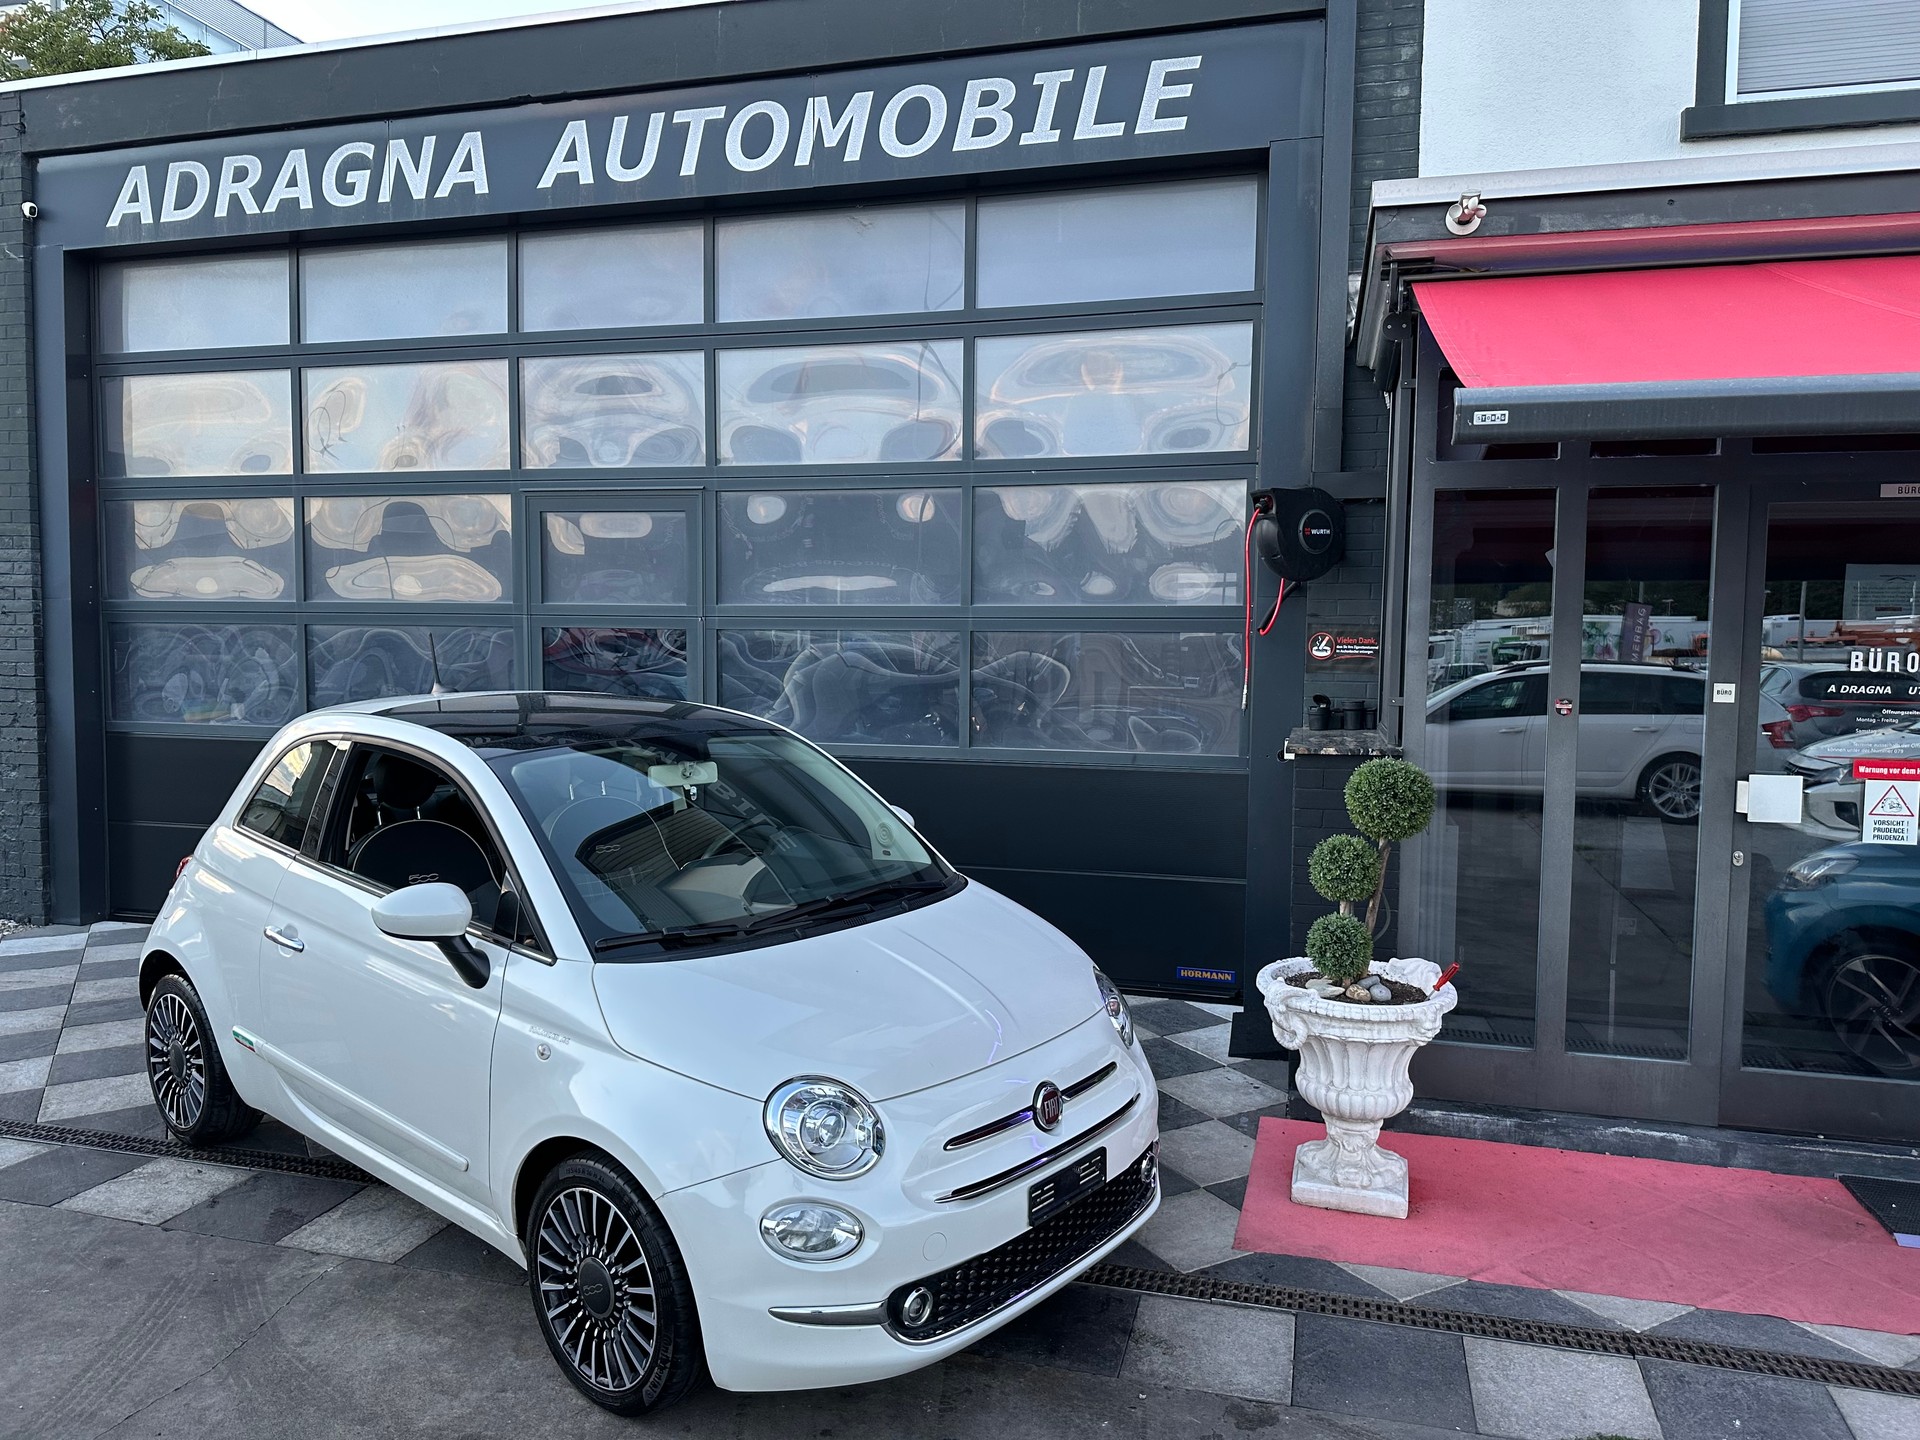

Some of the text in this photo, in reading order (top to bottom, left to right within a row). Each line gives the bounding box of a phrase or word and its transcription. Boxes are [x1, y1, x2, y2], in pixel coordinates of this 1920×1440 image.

[106, 55, 1203, 228] ADRAGNA AUTOMOBILE
[1336, 636, 1357, 644] Vielen
[1631, 608, 1647, 663] MERBAG
[1850, 648, 1920, 673] BÜRO
[1858, 766, 1888, 774] Warnung
[1873, 819, 1905, 827] VORSICHT
[1043, 1095, 1059, 1120] FIAT
